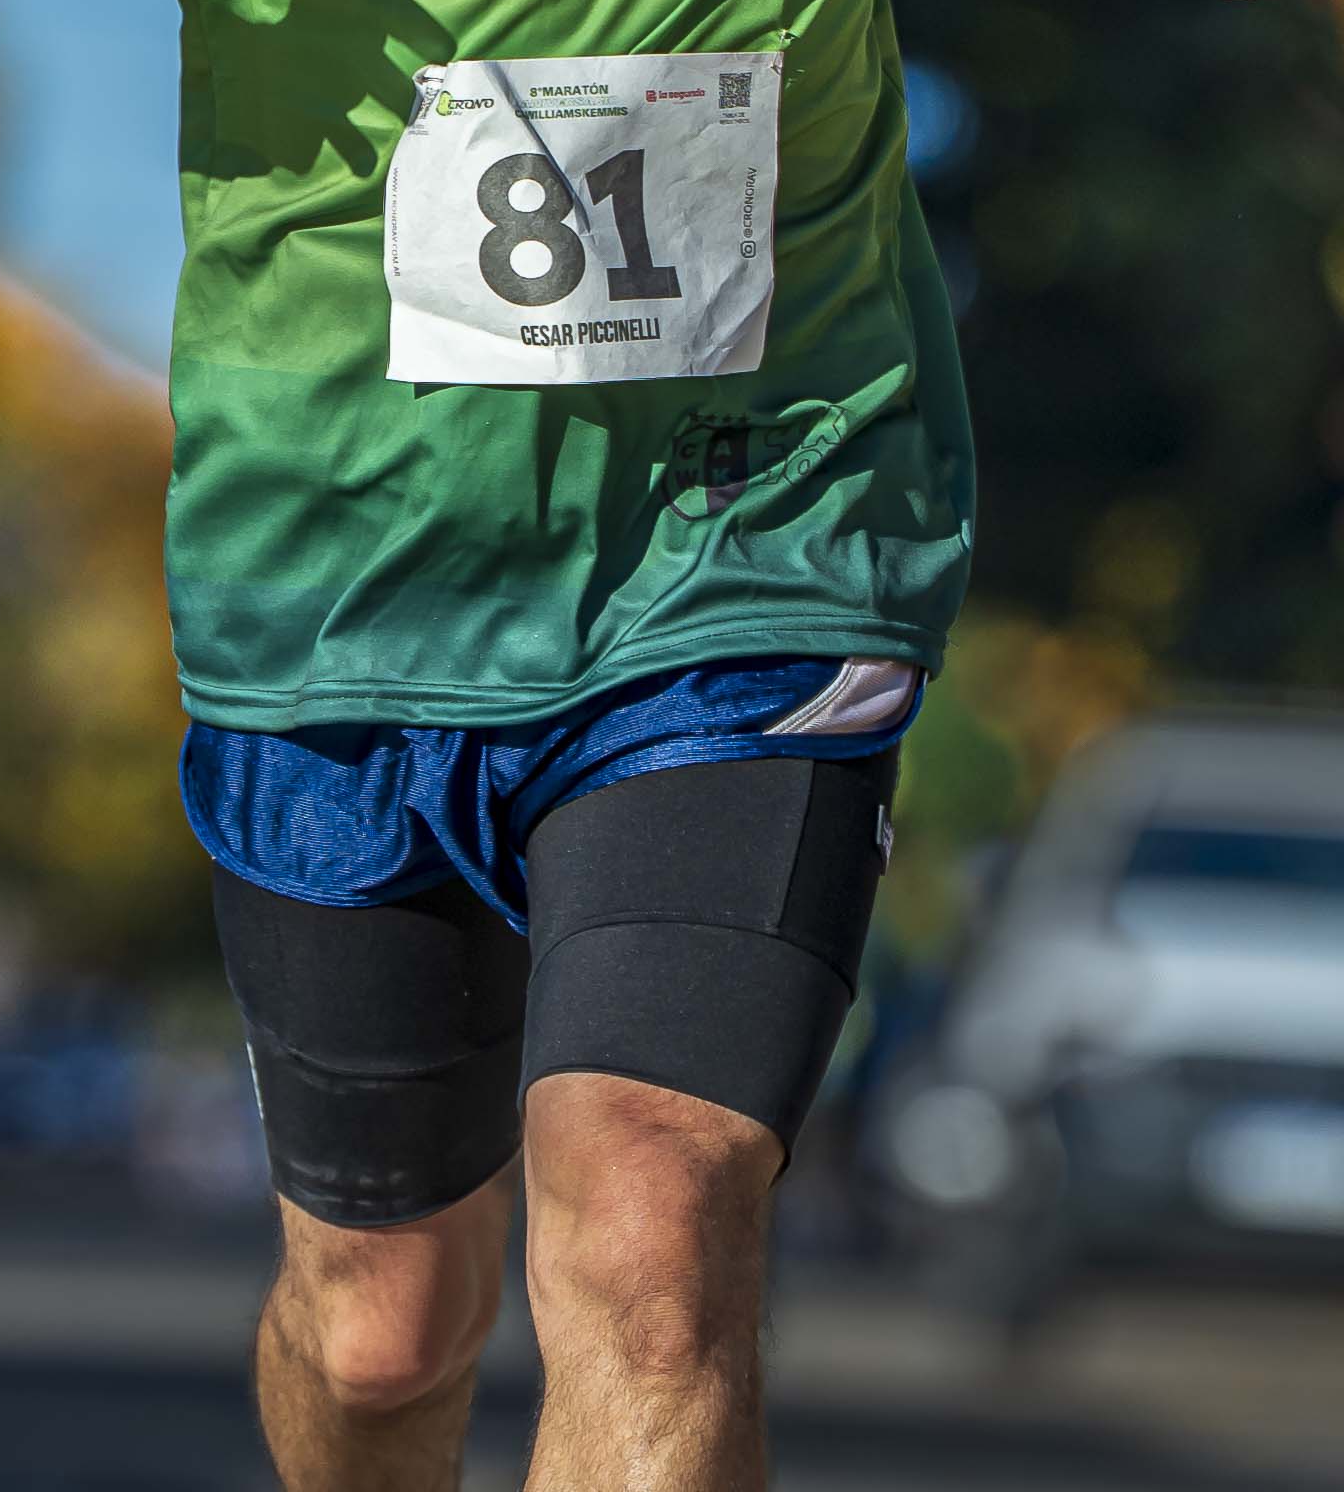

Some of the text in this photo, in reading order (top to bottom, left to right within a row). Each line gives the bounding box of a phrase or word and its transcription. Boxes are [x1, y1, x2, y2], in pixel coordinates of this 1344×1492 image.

[477, 149, 682, 307] 81
[520, 317, 661, 346] CESAR PICCINELLI
